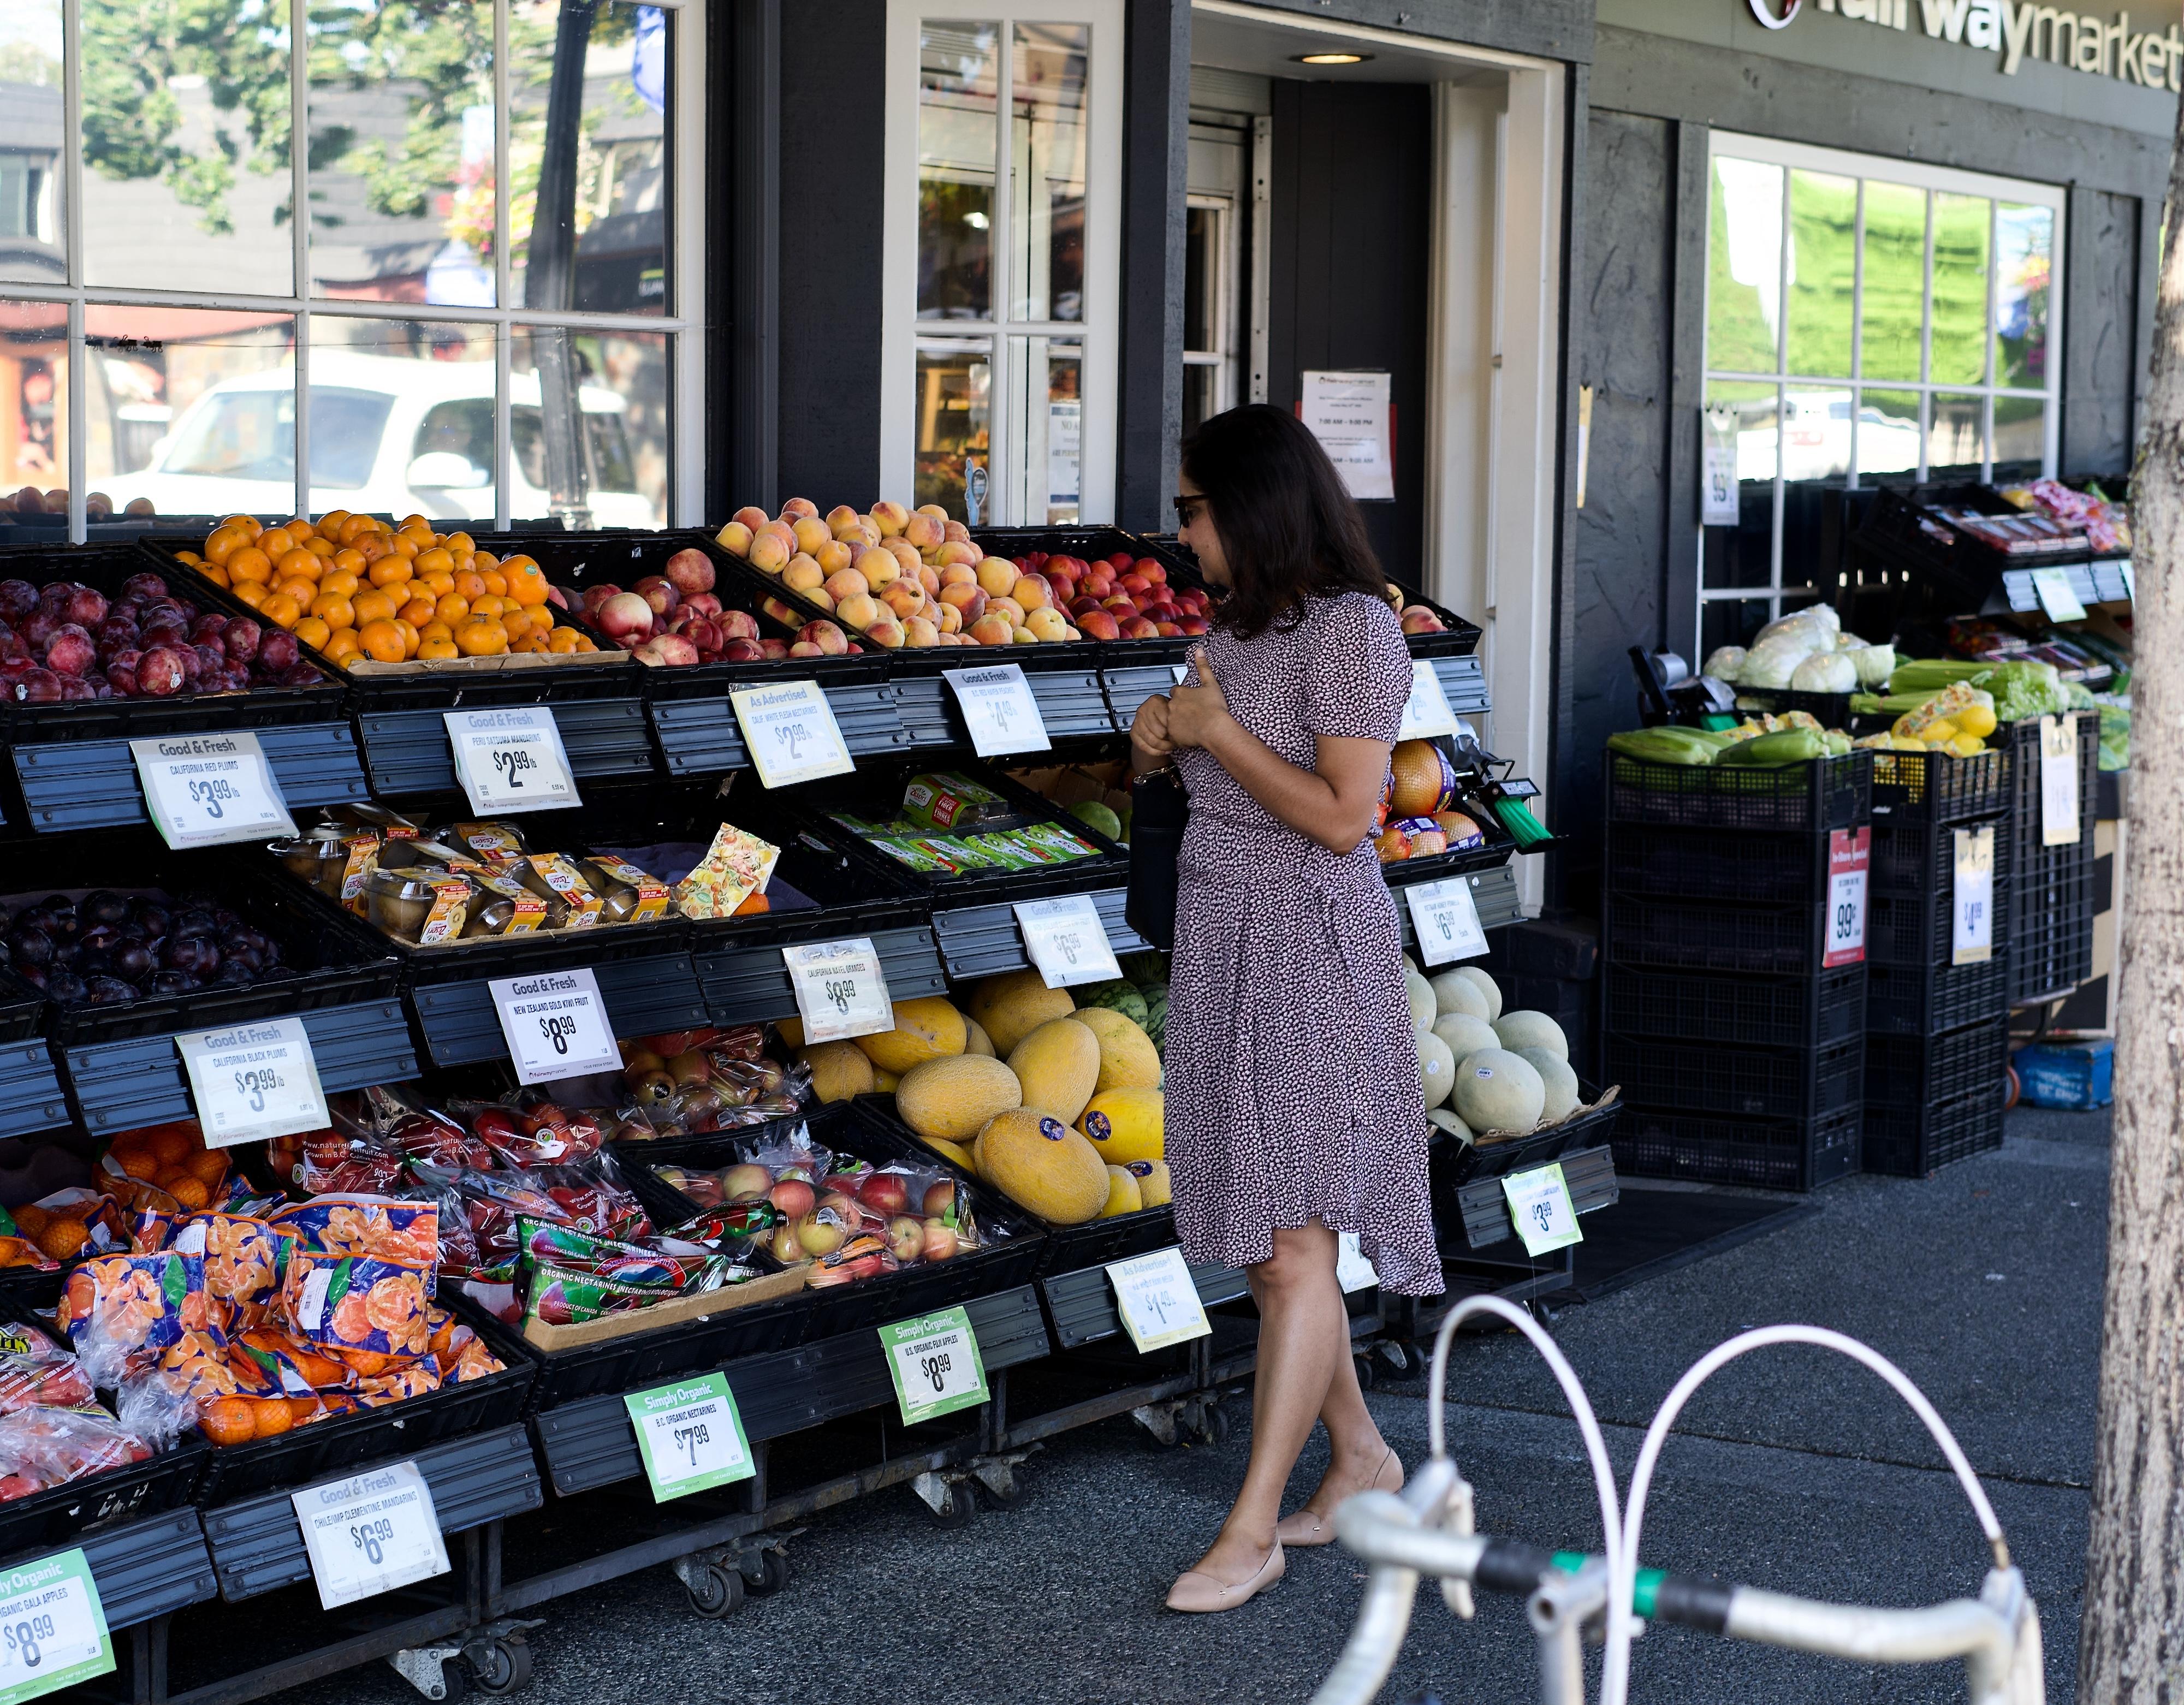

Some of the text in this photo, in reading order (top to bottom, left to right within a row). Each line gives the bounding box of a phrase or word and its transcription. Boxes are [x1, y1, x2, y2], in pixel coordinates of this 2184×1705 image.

[1061, 421, 1072, 430] NO
[962, 673, 983, 683] Good
[988, 670, 1010, 681] Fresh
[750, 687, 808, 708] As Advertised
[468, 713, 534, 728] Good & Fresh
[766, 713, 779, 721] WHITE
[779, 711, 792, 720] FLESH
[792, 706, 817, 717] NECTARINES
[159, 738, 236, 756] Good & Fresh
[472, 734, 541, 746] PERU SATSUMA MANDARINS
[170, 761, 238, 775] CALIFORNIA RED PLUMS
[1031, 905, 1052, 915] Good
[808, 968, 832, 977] CALIFORNIA
[847, 964, 865, 973] ORANGES
[512, 976, 577, 995] Good & Fresh
[514, 997, 589, 1015] NEW ZEALAND GOLD KIWI FRUIT
[205, 1026, 281, 1048] Good & Fresh
[213, 1048, 287, 1068] CALIFORNIA BLACK PLUMS
[523, 1218, 558, 1230] ORGANIC
[559, 1227, 602, 1244] NECTARINES
[545, 1245, 567, 1254] PRODUCT
[1123, 1258, 1171, 1276] As Advertised
[541, 1269, 573, 1281] ORGANIC
[575, 1275, 617, 1291] NECTARINES
[554, 1300, 575, 1310] PRODUCT
[895, 1315, 954, 1339] Simply Organic
[905, 1334, 958, 1356] U.S. ORGANIC FUJI APPLES
[644, 1383, 713, 1410] Simply Organic
[656, 1404, 716, 1428] B.C. ORGANIC NECTARINES
[319, 1484, 351, 1505] Good
[363, 1472, 397, 1492] Fresh
[382, 1491, 417, 1510] MANDARINS
[11, 1563, 64, 1588] Organic
[0, 1588, 68, 1619] GANIC GALA APPLES
